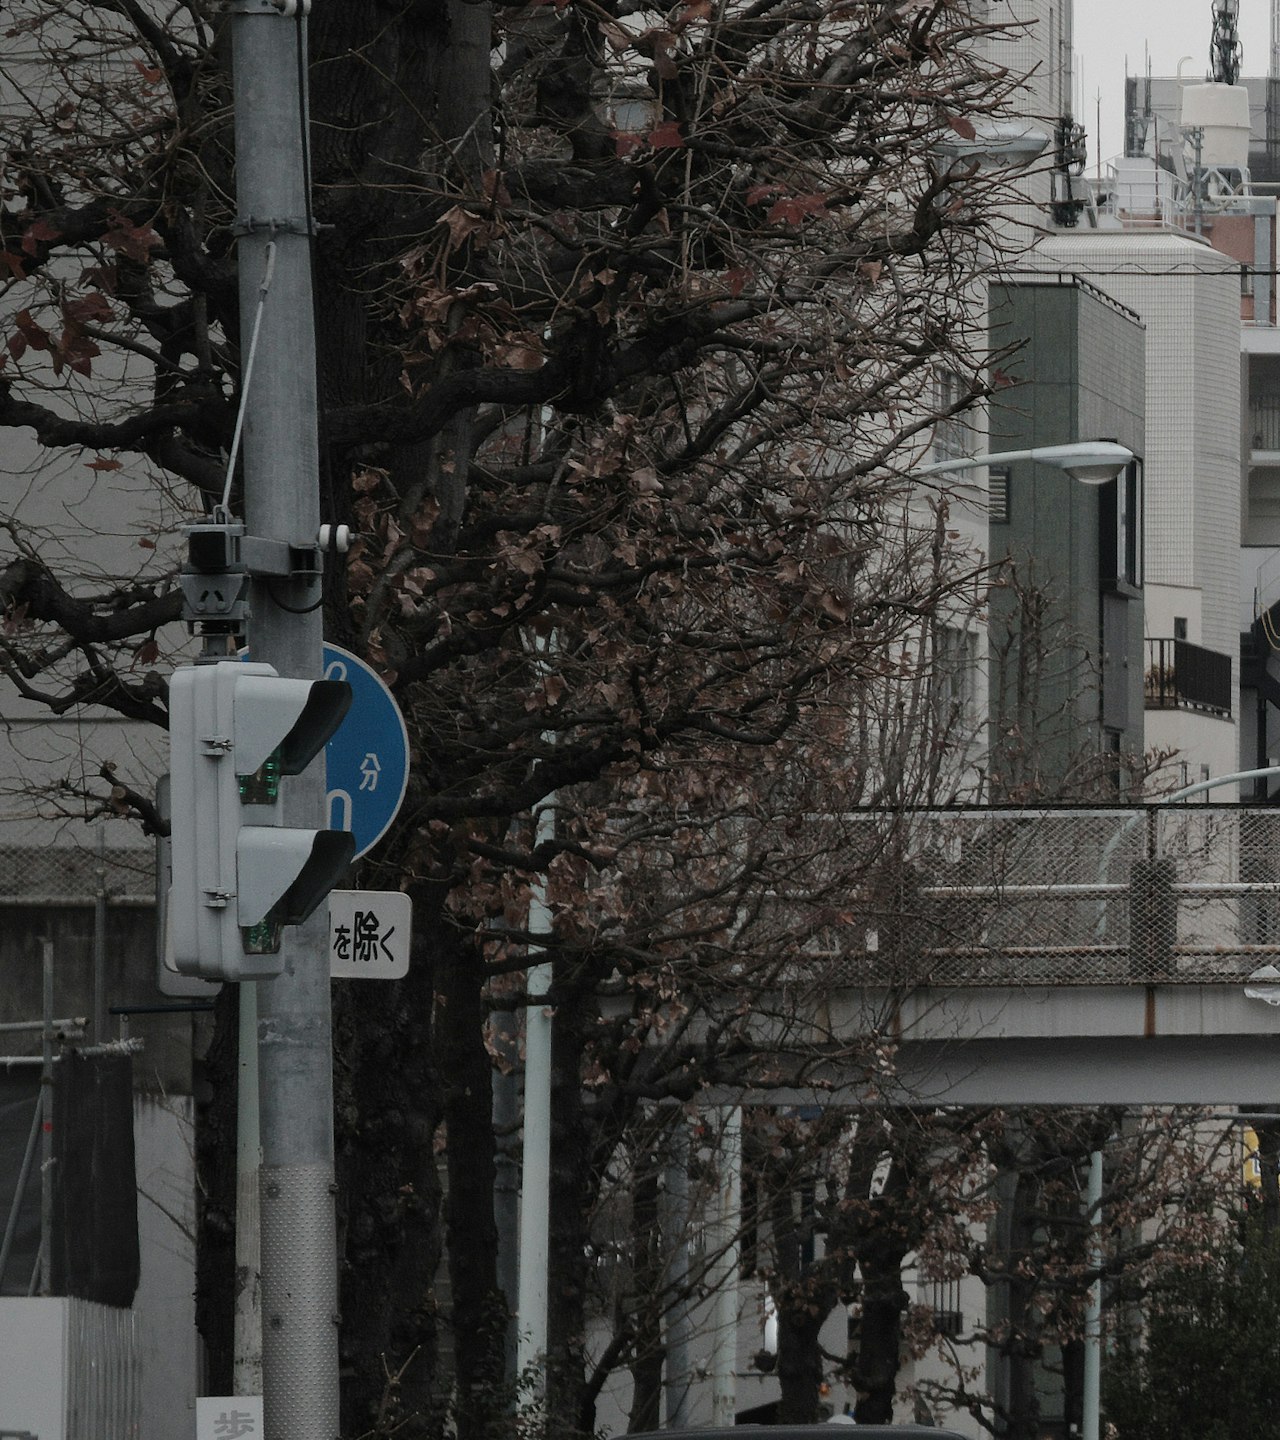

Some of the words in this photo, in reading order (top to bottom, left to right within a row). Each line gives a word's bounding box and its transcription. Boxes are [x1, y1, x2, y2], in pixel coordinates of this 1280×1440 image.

[359, 752, 382, 792] 分
[329, 911, 395, 962] を除く
